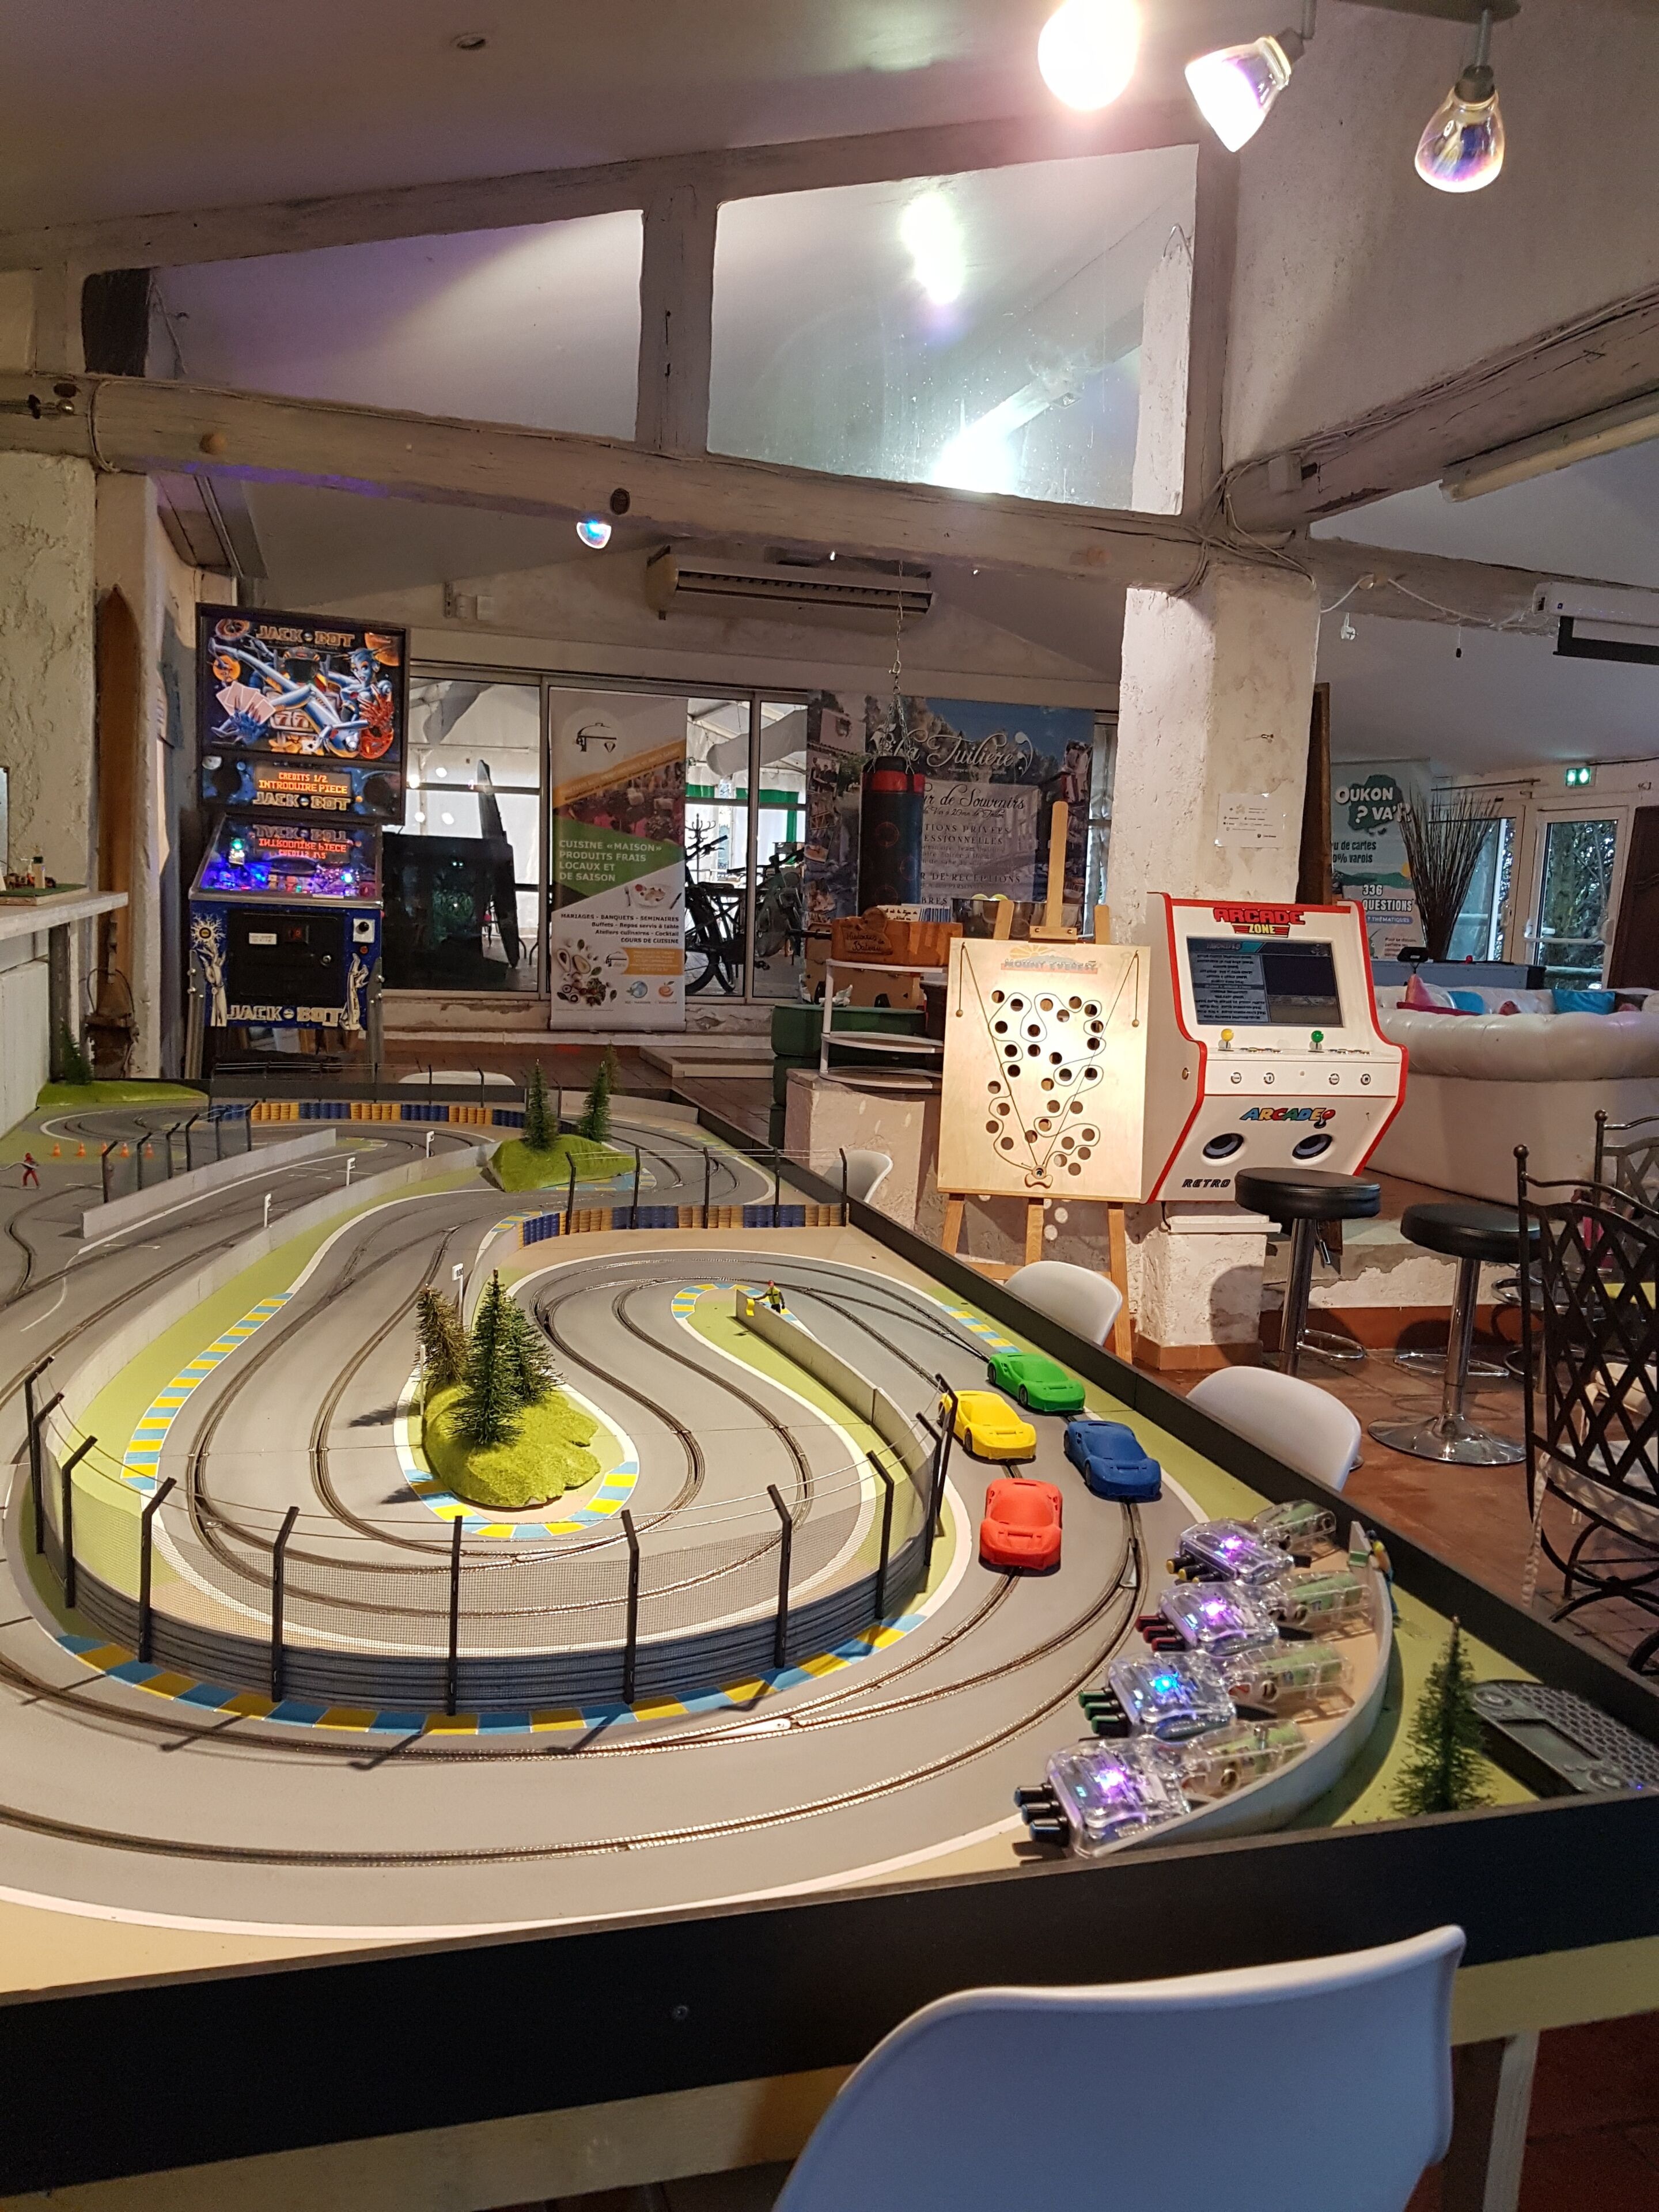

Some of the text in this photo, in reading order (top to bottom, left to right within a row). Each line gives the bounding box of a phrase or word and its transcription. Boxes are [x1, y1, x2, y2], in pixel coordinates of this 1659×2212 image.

[256, 625, 303, 642] JACK
[315, 631, 355, 647] BOT
[278, 772, 310, 782] CREDITS
[259, 779, 347, 794] INTRODUIRE PIECE
[252, 791, 351, 810] JACK BOT
[960, 789, 1025, 809] Souvenirs
[1335, 786, 1393, 804] OUKON
[925, 824, 957, 832] TIONS
[559, 840, 603, 850] CUISINE
[924, 835, 1002, 844] ESSIONNELLES
[1341, 841, 1350, 850] de
[1352, 841, 1376, 850] cartes
[559, 851, 646, 862] PRODUITS FRAIS
[1333, 853, 1373, 863] 0% varois
[559, 862, 600, 870] LOCAUX
[577, 873, 615, 881] SAISON
[1362, 884, 1383, 896] 336
[1362, 899, 1412, 912] QUESTIONS
[1213, 907, 1305, 925] ARCADE
[1249, 924, 1275, 934] ZONE
[226, 1005, 344, 1027] JACK BOT
[1239, 1107, 1327, 1120] ARCADE
[1181, 1179, 1231, 1188] RETRO
